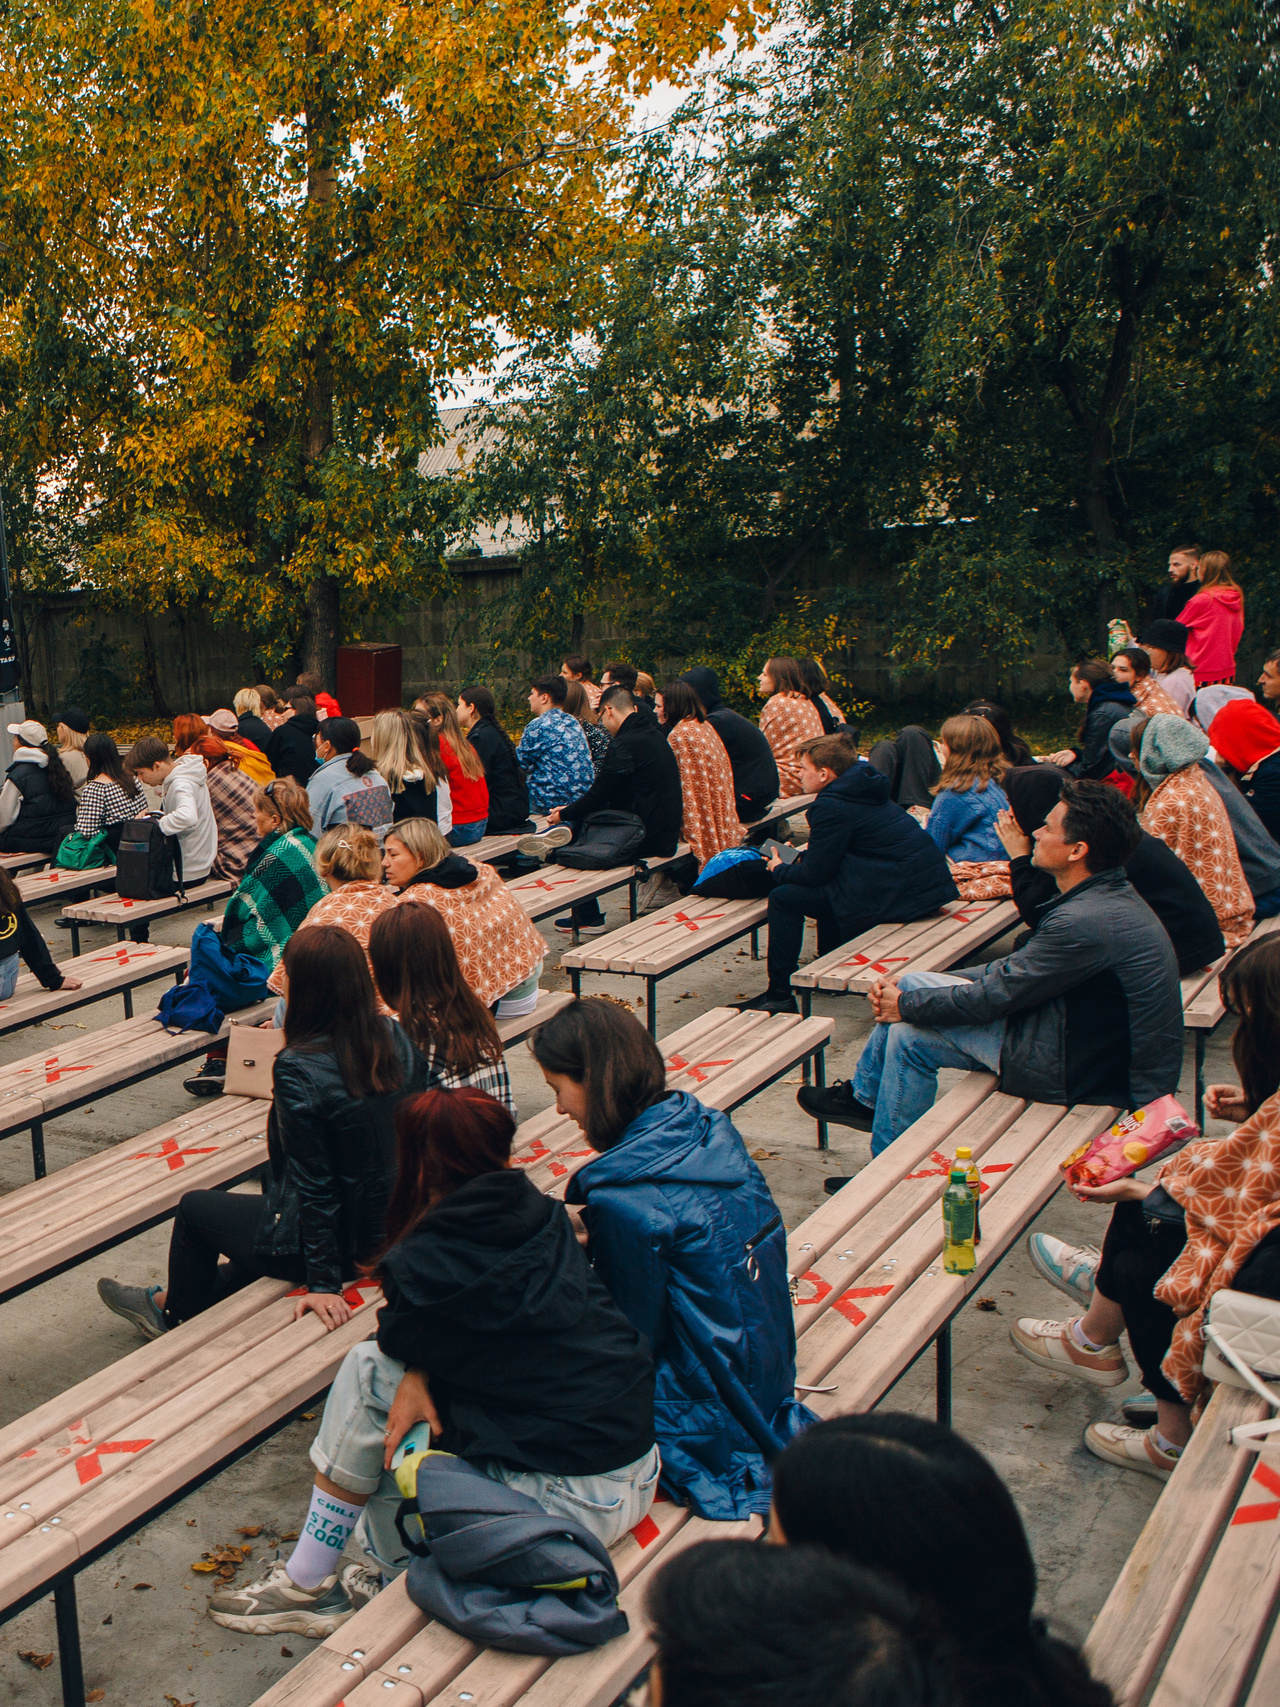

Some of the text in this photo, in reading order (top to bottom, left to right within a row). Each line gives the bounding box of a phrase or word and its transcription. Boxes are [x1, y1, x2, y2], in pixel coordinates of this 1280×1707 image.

[317, 1498, 356, 1519] CHILL
[306, 1522, 345, 1550] COOL
[310, 1511, 354, 1538] STAY
